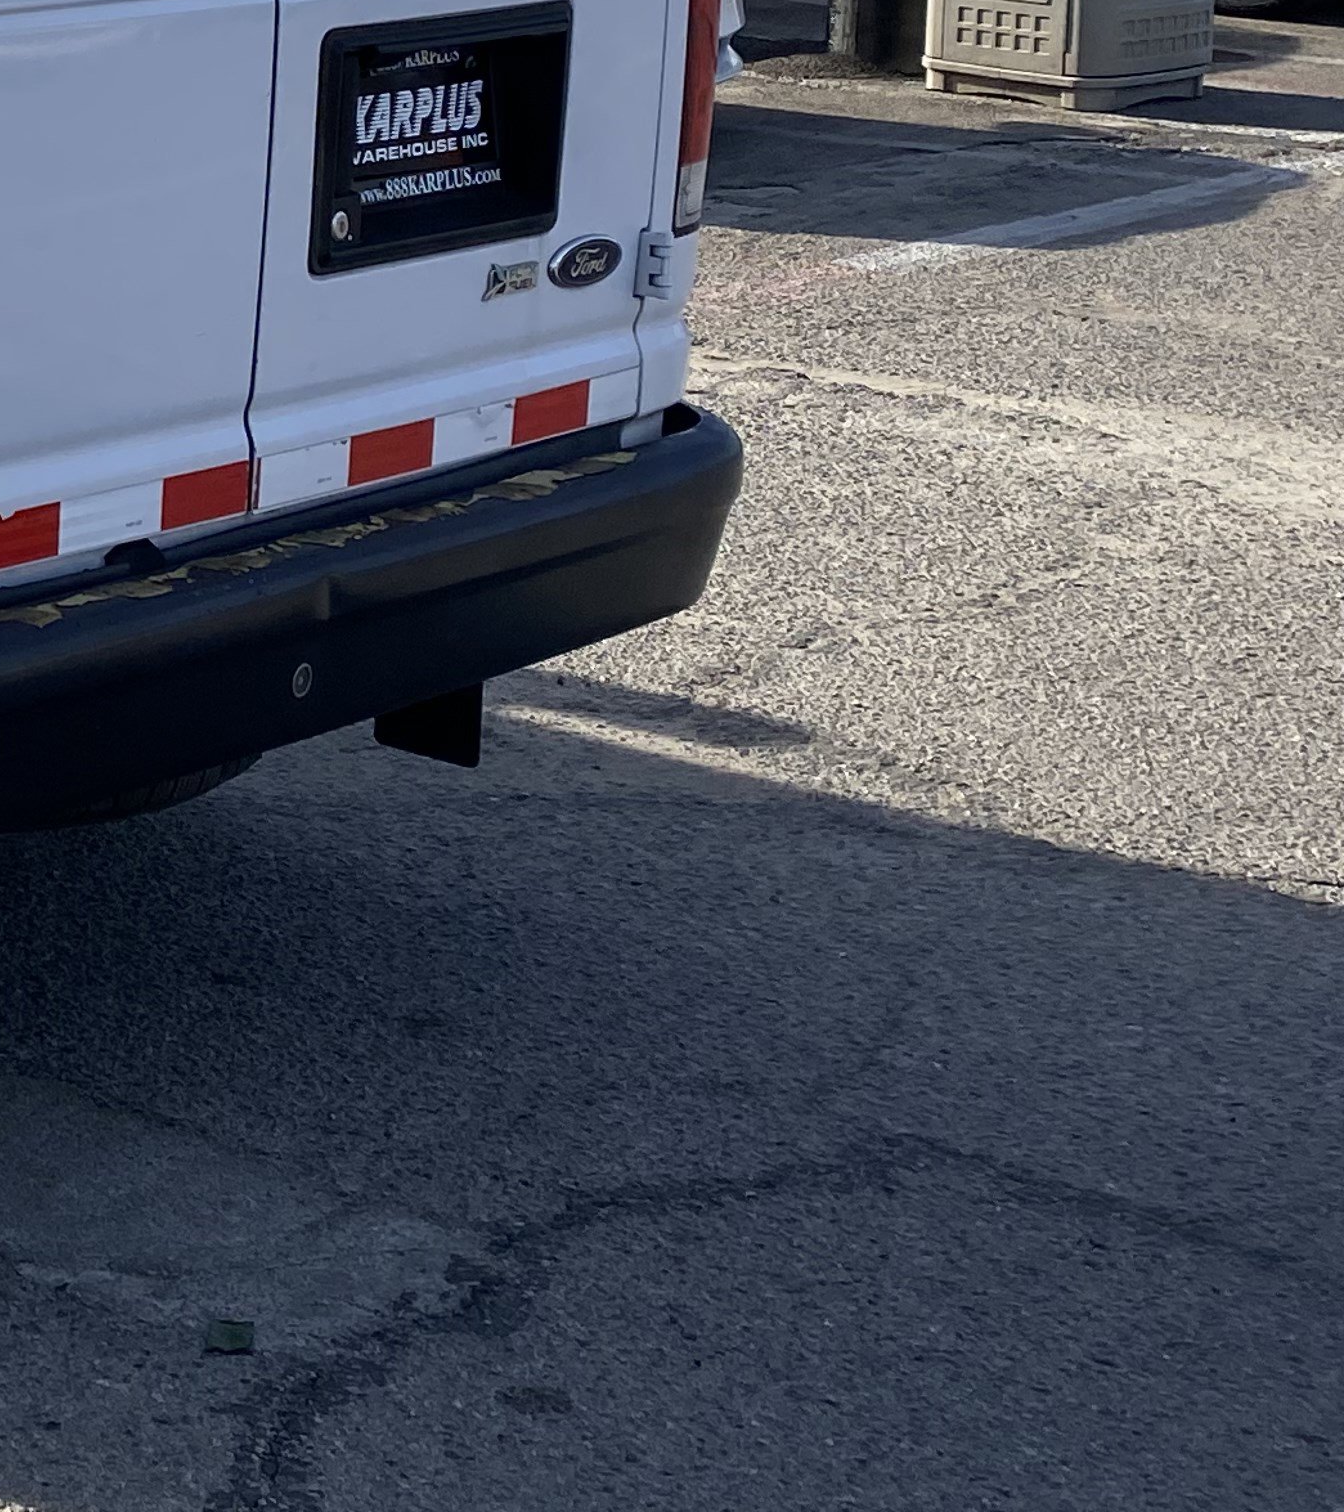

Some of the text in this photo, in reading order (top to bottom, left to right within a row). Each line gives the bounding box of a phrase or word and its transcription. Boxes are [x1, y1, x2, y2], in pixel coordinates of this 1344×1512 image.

[355, 79, 484, 145] KARPLUS
[462, 132, 489, 149] INC
[571, 247, 609, 278] Ford
